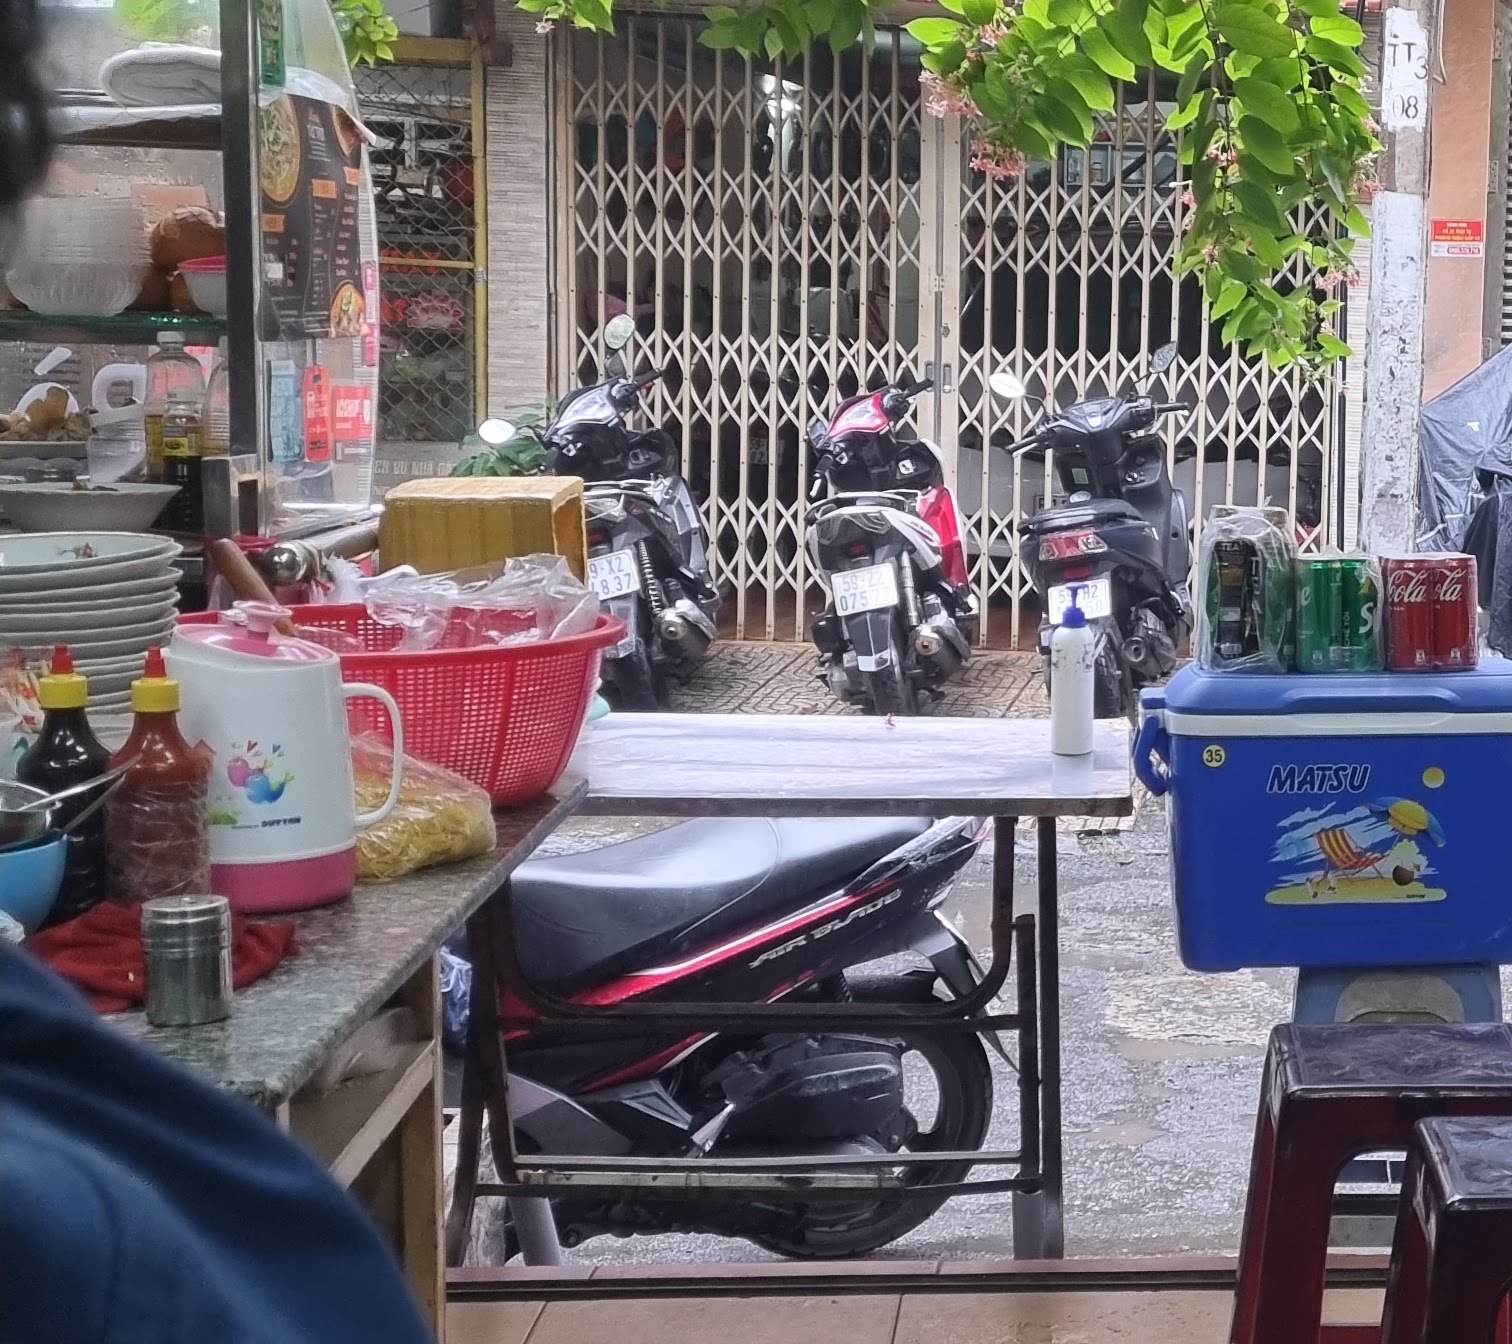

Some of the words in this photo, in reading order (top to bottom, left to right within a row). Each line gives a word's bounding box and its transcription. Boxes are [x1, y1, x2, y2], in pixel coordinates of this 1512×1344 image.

[1392, 94, 1419, 119] 08
[1221, 542, 1239, 552] TEA
[1205, 749, 1223, 763] 35
[1266, 764, 1371, 794] MATSU
